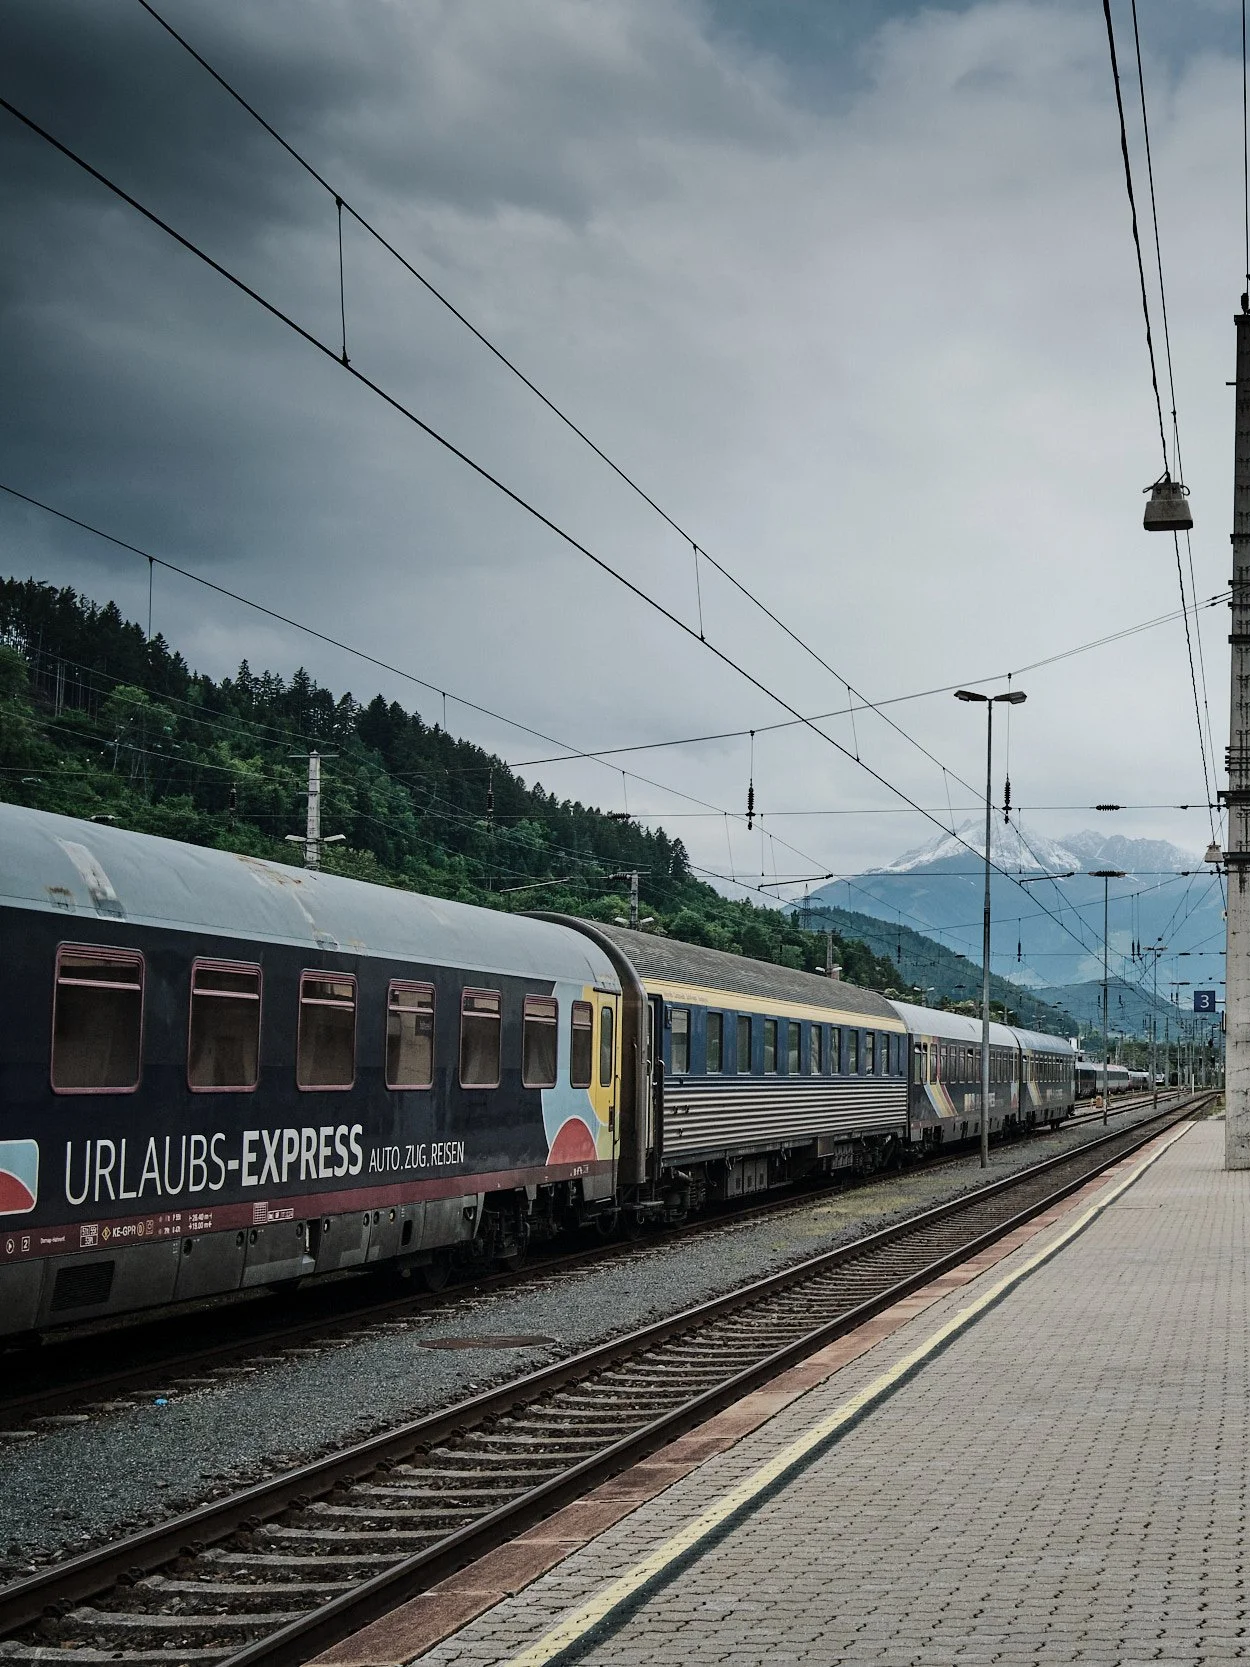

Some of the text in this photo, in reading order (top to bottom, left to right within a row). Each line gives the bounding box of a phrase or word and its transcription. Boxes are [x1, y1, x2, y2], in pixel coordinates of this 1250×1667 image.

[1200, 994, 1210, 1009] 3
[65, 1124, 363, 1205] URLAUBS-EXPRESS
[368, 1141, 465, 1173] AUTO.ZUG.REISEN
[112, 1225, 136, 1237] KE-GPR
